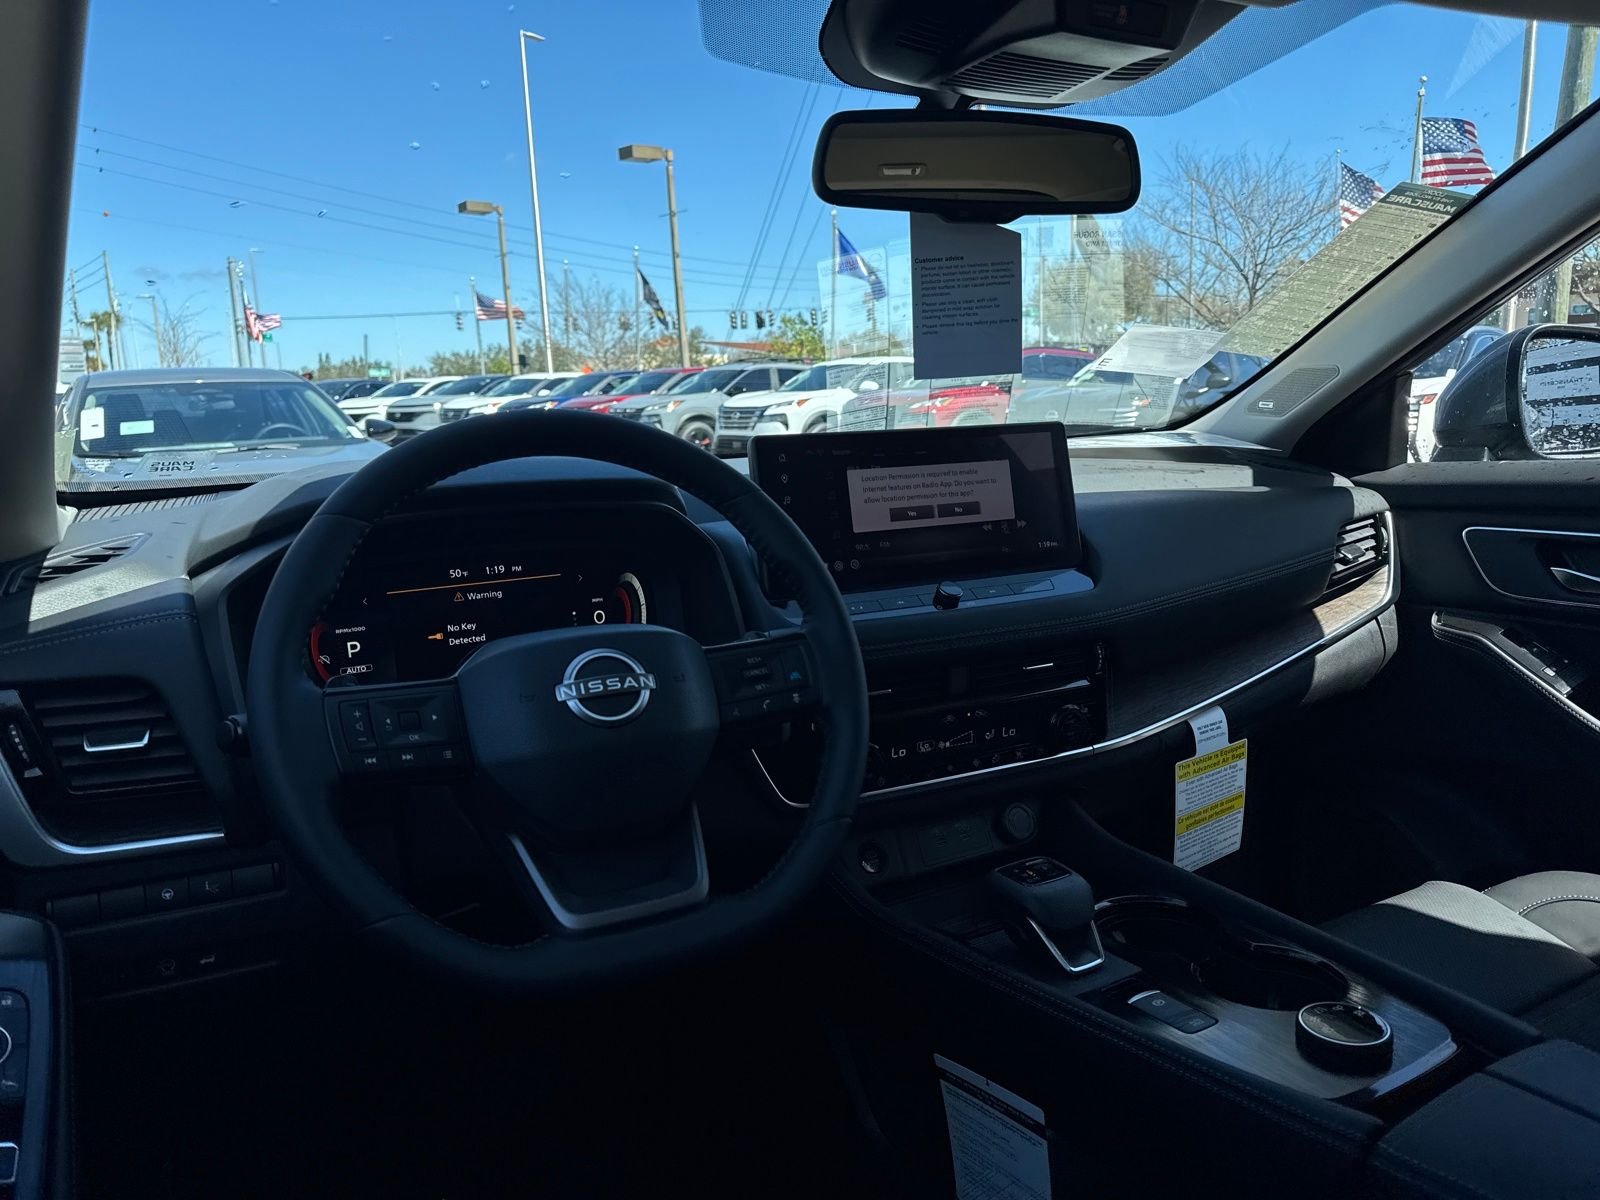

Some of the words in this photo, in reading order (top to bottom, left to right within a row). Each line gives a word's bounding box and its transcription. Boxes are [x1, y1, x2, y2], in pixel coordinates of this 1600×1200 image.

[861, 474, 887, 482] Location
[888, 472, 920, 481] Permission
[926, 470, 950, 479] required
[959, 468, 978, 476] enable
[888, 484, 912, 492] features
[907, 493, 937, 502] permission
[486, 564, 505, 575] 1:19
[466, 590, 503, 600] Warning
[594, 609, 606, 624] 0
[447, 624, 460, 632] No
[461, 622, 477, 631] Key
[448, 633, 486, 646] Detected
[346, 641, 361, 658] P
[346, 665, 367, 674] AUTO
[559, 676, 654, 699] NISSAN
[1002, 728, 1016, 737] Lo
[891, 747, 906, 758] Lo
[1178, 764, 1190, 772] This
[1192, 755, 1212, 767] Vehicle
[1220, 744, 1245, 757] Equipped
[1179, 772, 1191, 780] with
[1193, 761, 1220, 775] Advanced
[1232, 752, 1245, 761] Bags
[1205, 770, 1223, 779] Advanced
